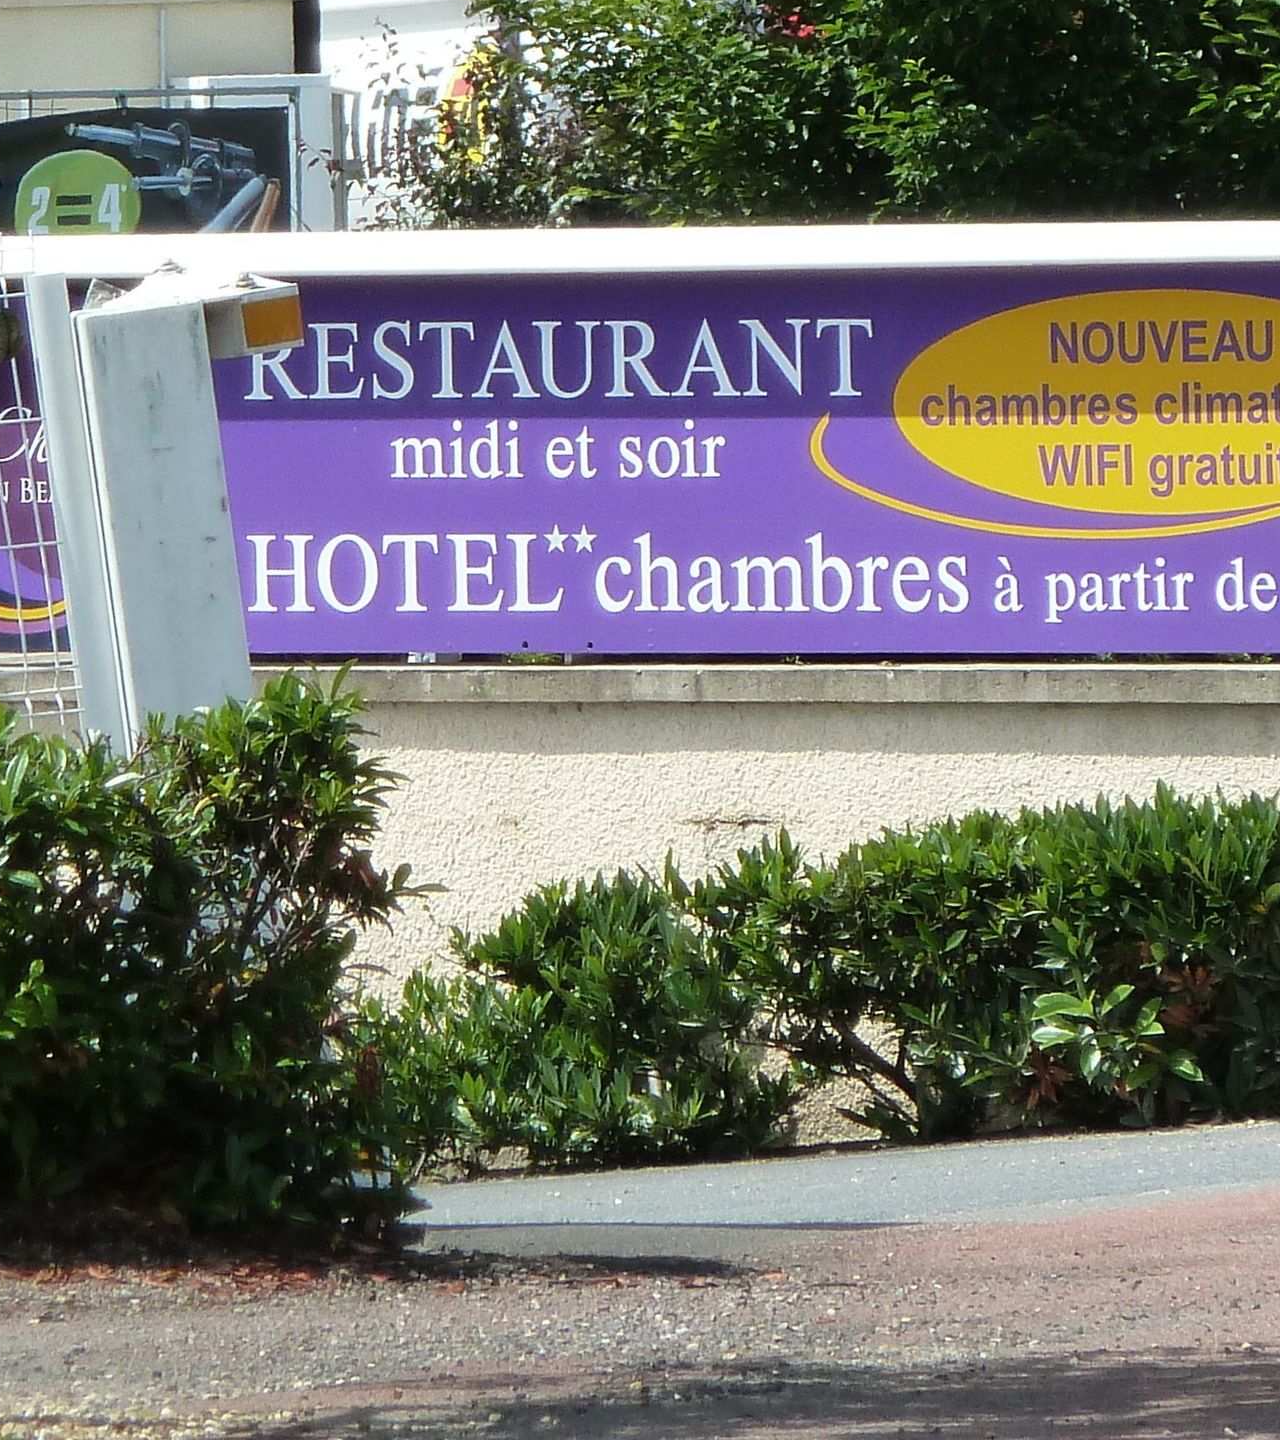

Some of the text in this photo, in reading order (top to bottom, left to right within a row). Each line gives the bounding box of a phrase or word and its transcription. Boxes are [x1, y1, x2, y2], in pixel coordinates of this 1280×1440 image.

[244, 318, 873, 401] RESTAURANT
[1049, 318, 1275, 364] NOUVEAU
[920, 383, 1139, 427] chambres
[390, 418, 726, 480] midi et soir
[1038, 444, 1133, 487] WIFI
[594, 530, 970, 615] chambres
[993, 557, 1024, 613] à
[1044, 557, 1195, 623] partir
[1214, 557, 1278, 613] de
